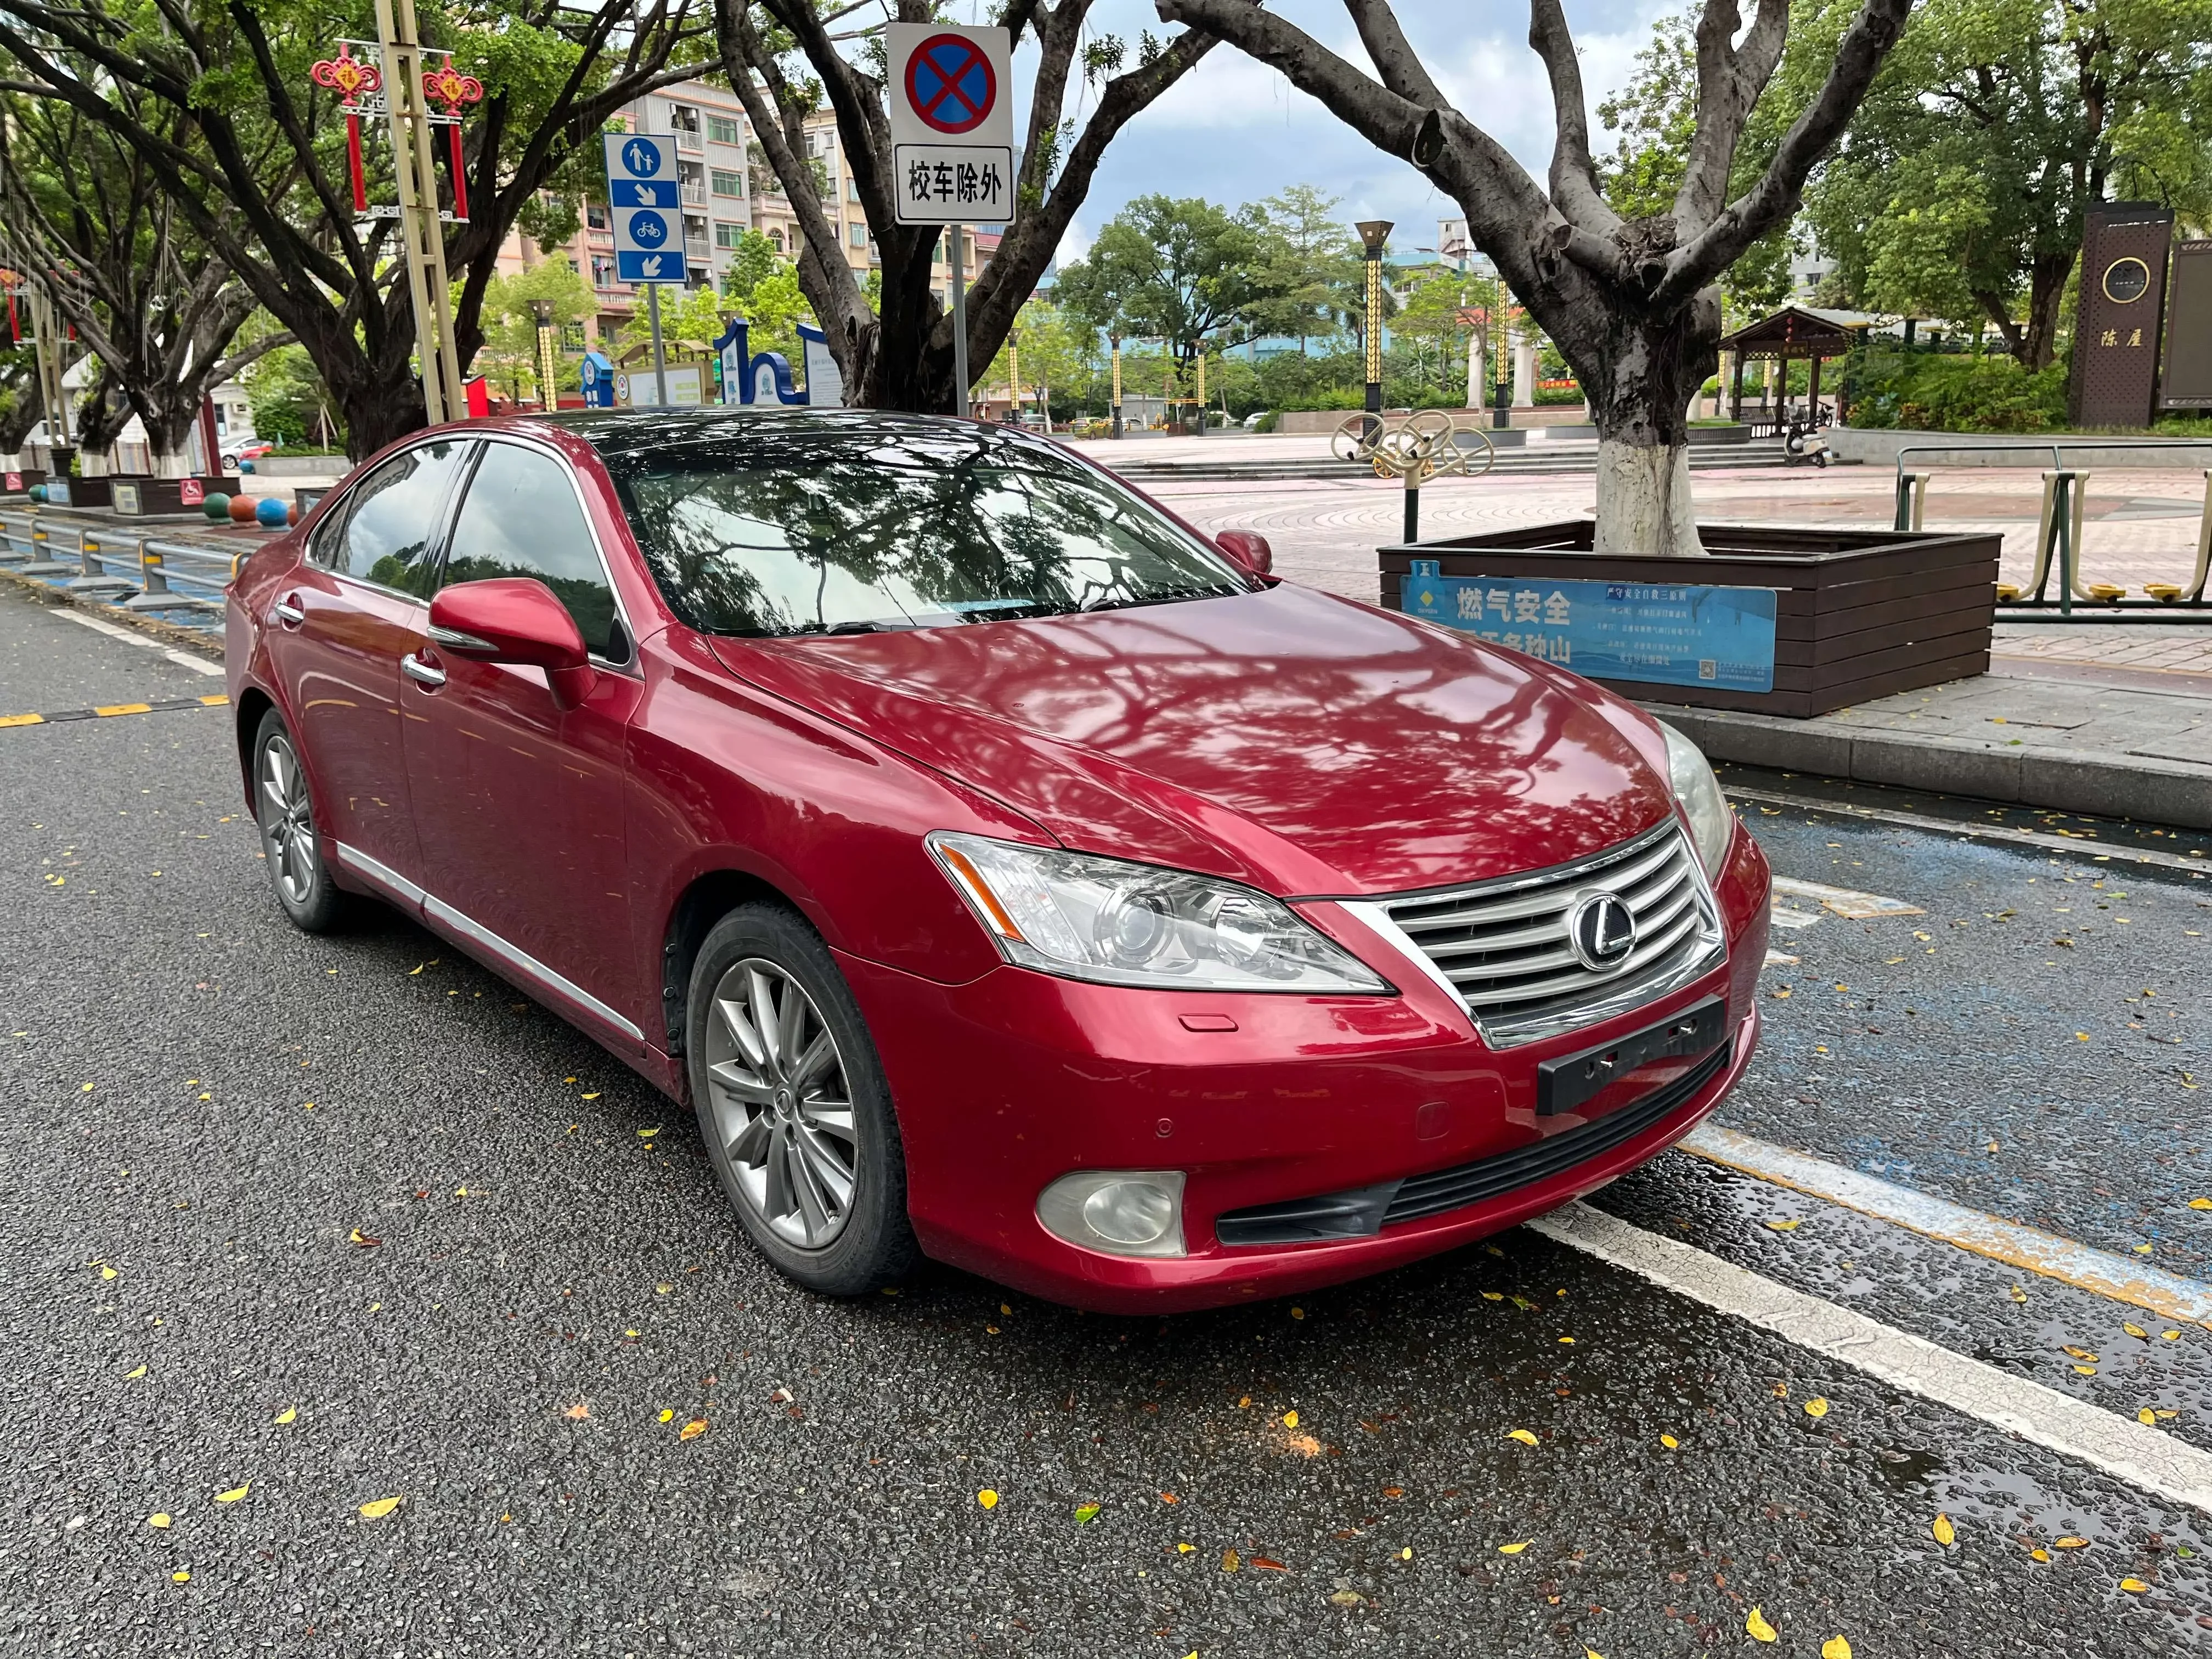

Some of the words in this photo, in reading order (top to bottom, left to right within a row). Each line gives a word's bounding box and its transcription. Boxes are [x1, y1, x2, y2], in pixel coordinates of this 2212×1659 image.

[909, 160, 1002, 205] 校车除外
[1457, 586, 1571, 625] 燃气安全
